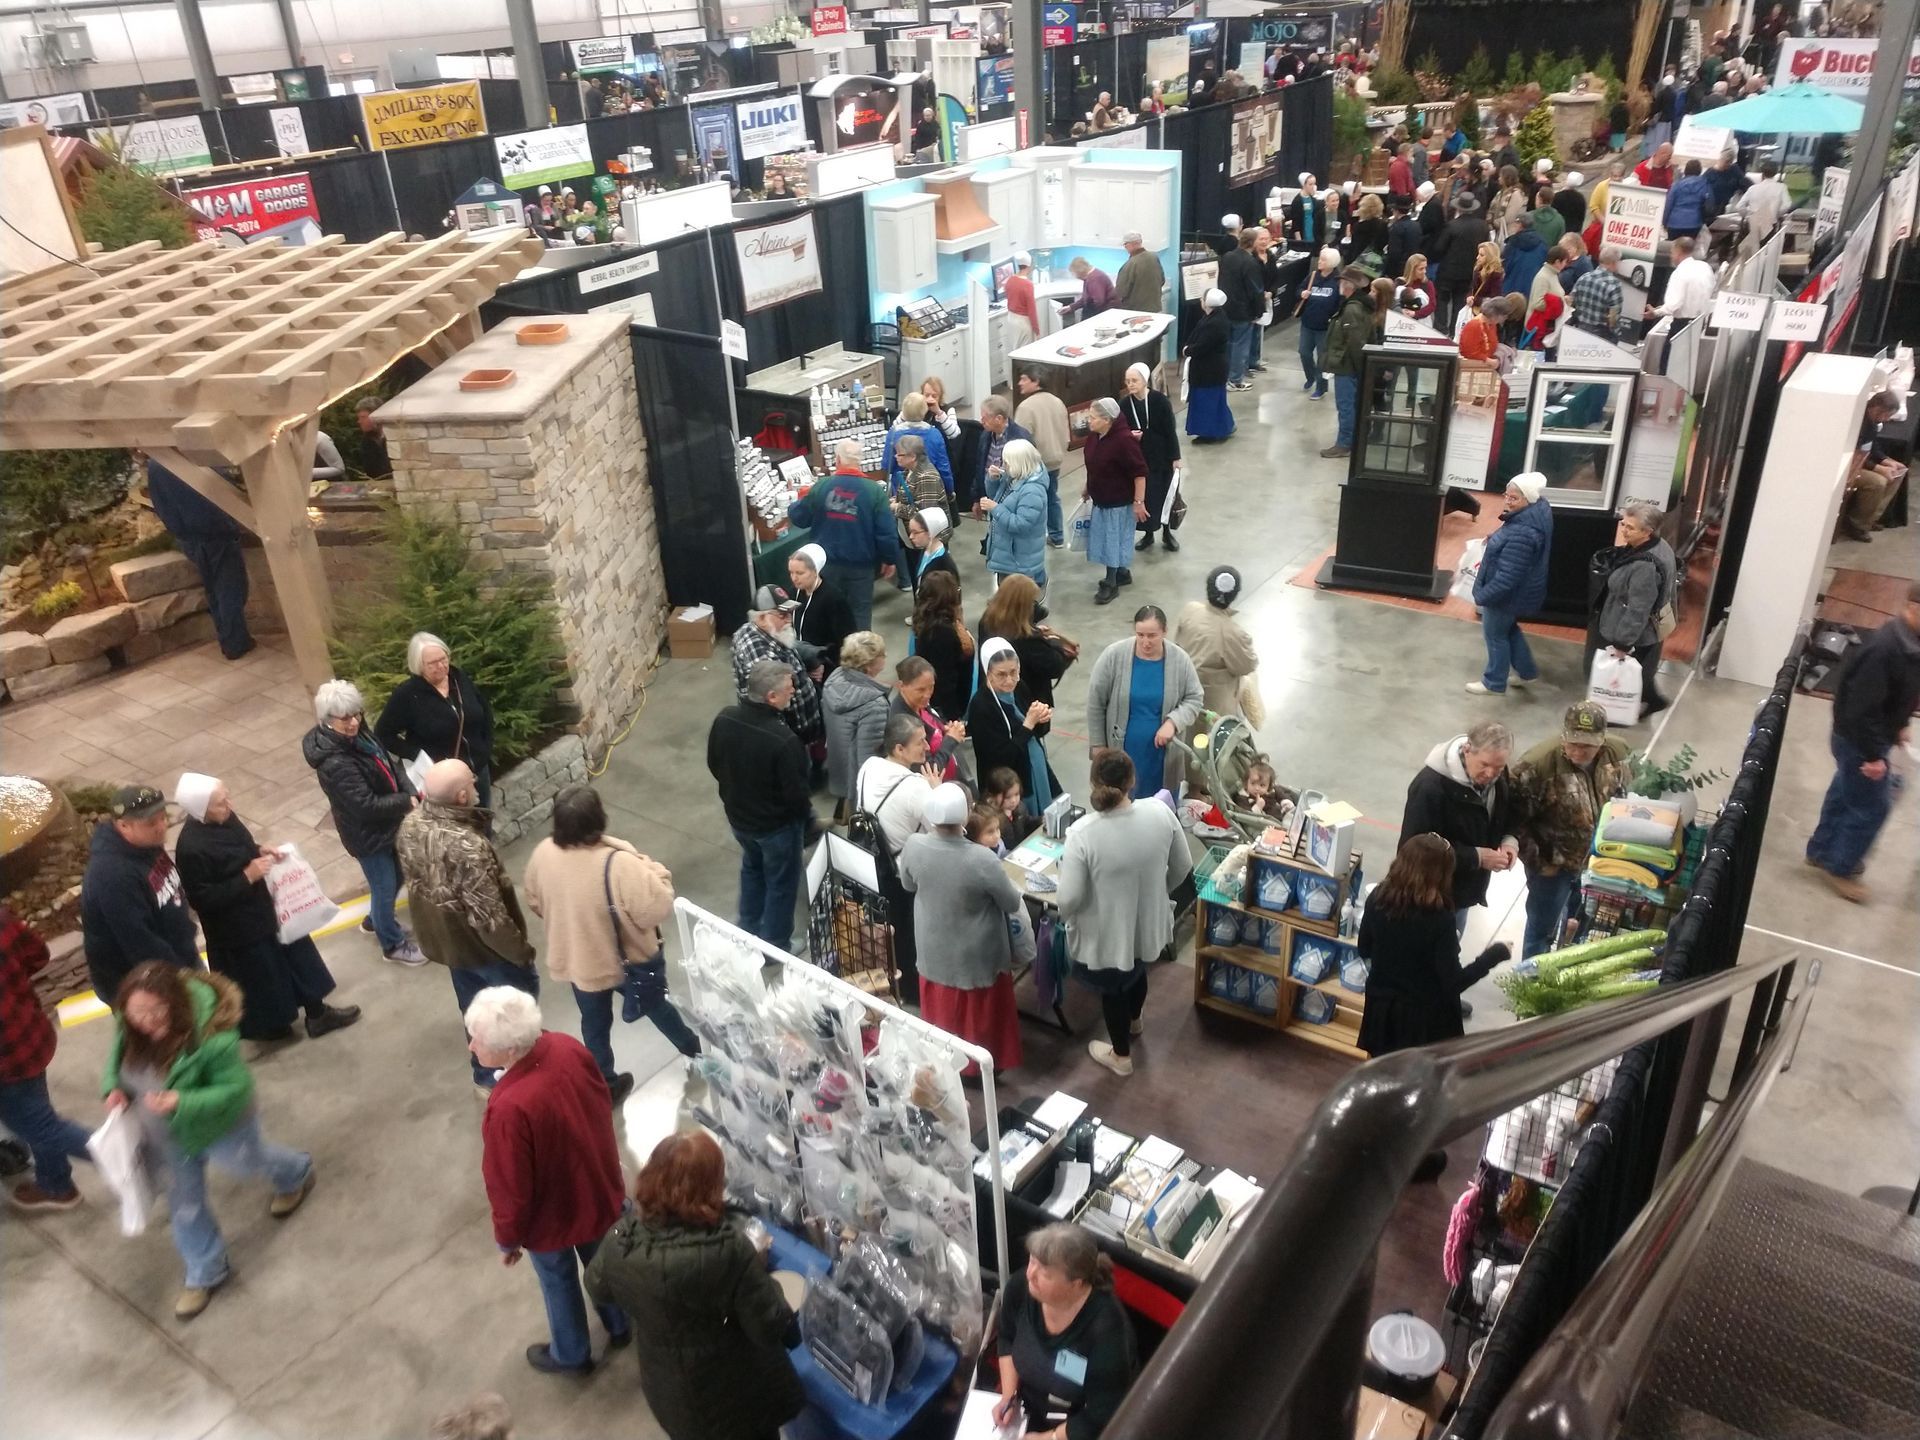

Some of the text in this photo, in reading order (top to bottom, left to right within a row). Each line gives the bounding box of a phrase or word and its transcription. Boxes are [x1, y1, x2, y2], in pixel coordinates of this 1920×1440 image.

[824, 10, 839, 21] Poly
[816, 20, 844, 32] Cabinets
[1250, 23, 1297, 42] MOJO
[447, 94, 475, 110] SON
[741, 104, 798, 131] JUKI
[378, 119, 479, 147] EXCAVATNG
[255, 182, 308, 202] GARAGE
[190, 188, 254, 221] M&M
[263, 196, 309, 214] DOORS
[1627, 197, 1660, 217] Miller
[1819, 207, 1840, 224] ONE
[197, 219, 261, 240] 330--2074
[1608, 220, 1654, 240] ONE DAY
[1606, 234, 1652, 251] GARAGE FLOORS
[590, 260, 650, 284] HERBAL HEALTH CONNECTION
[1726, 297, 1758, 307] ROW
[1728, 310, 1749, 320] 700
[1784, 307, 1817, 318] ROW
[1785, 321, 1807, 331] 800
[1563, 348, 1613, 359] WINDOWS
